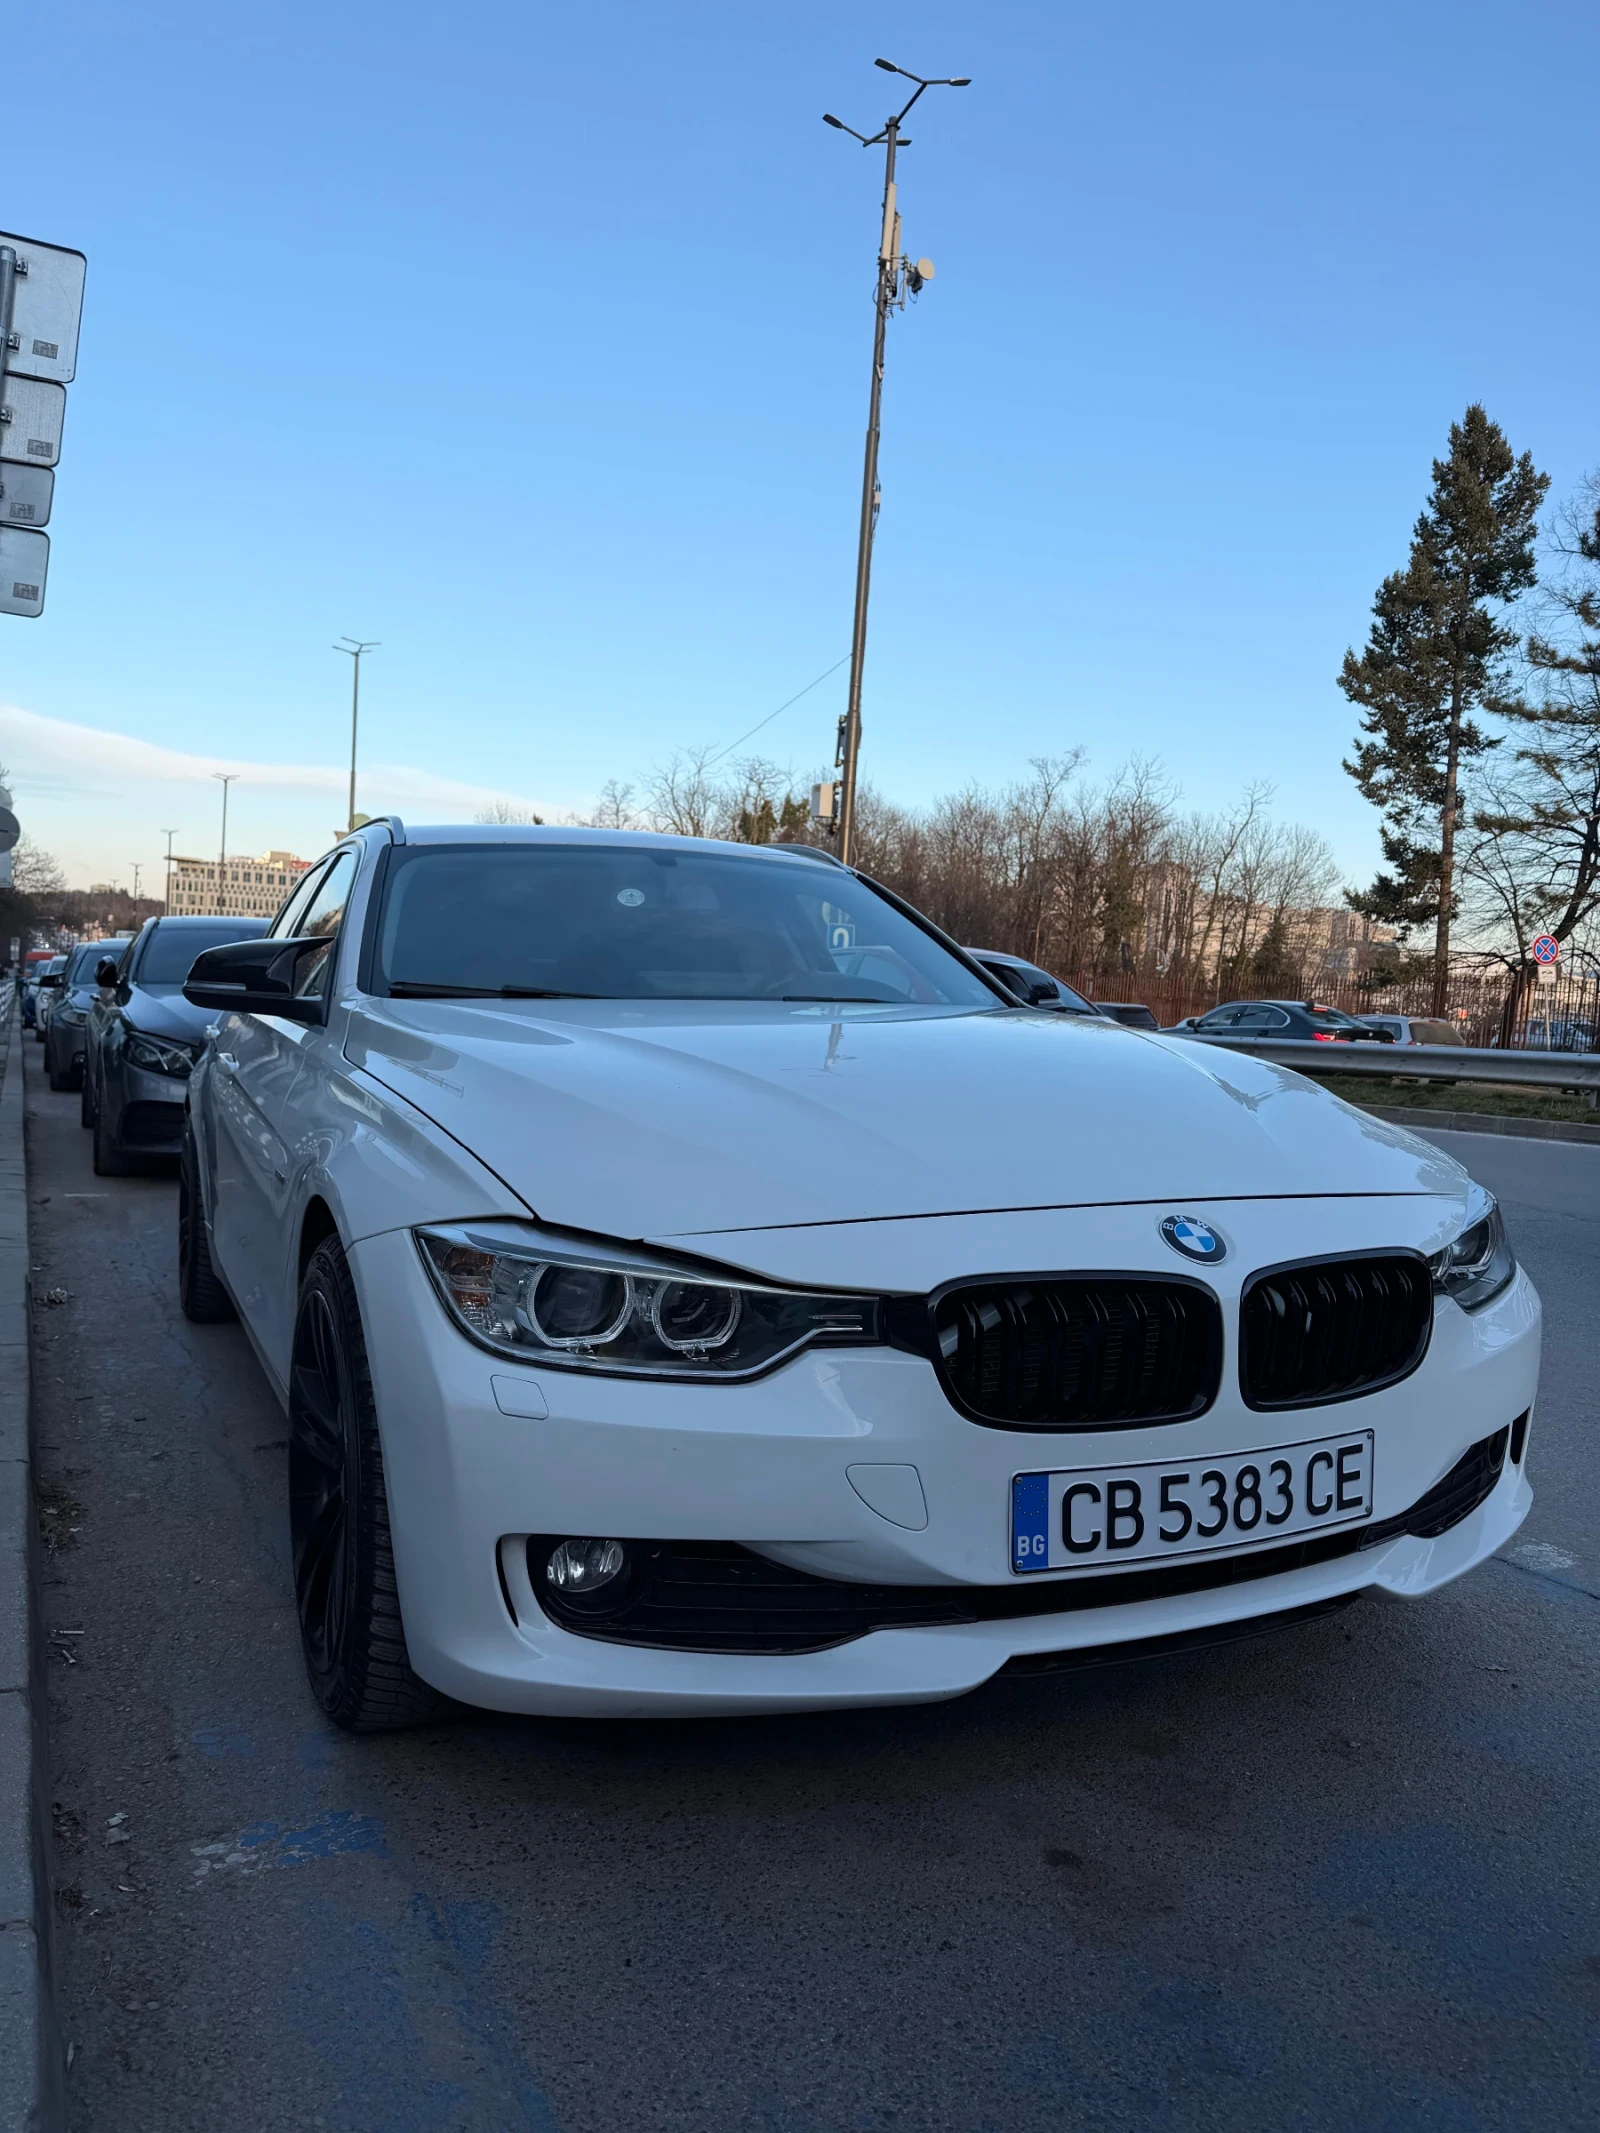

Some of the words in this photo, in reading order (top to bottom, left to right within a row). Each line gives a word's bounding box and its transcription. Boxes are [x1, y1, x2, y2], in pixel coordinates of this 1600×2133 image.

[1163, 1215, 1208, 1231] BMW
[1061, 1479, 1144, 1554] CB
[1159, 1459, 1294, 1542] 5383
[1306, 1444, 1364, 1516] CE
[1017, 1534, 1045, 1556] BG
